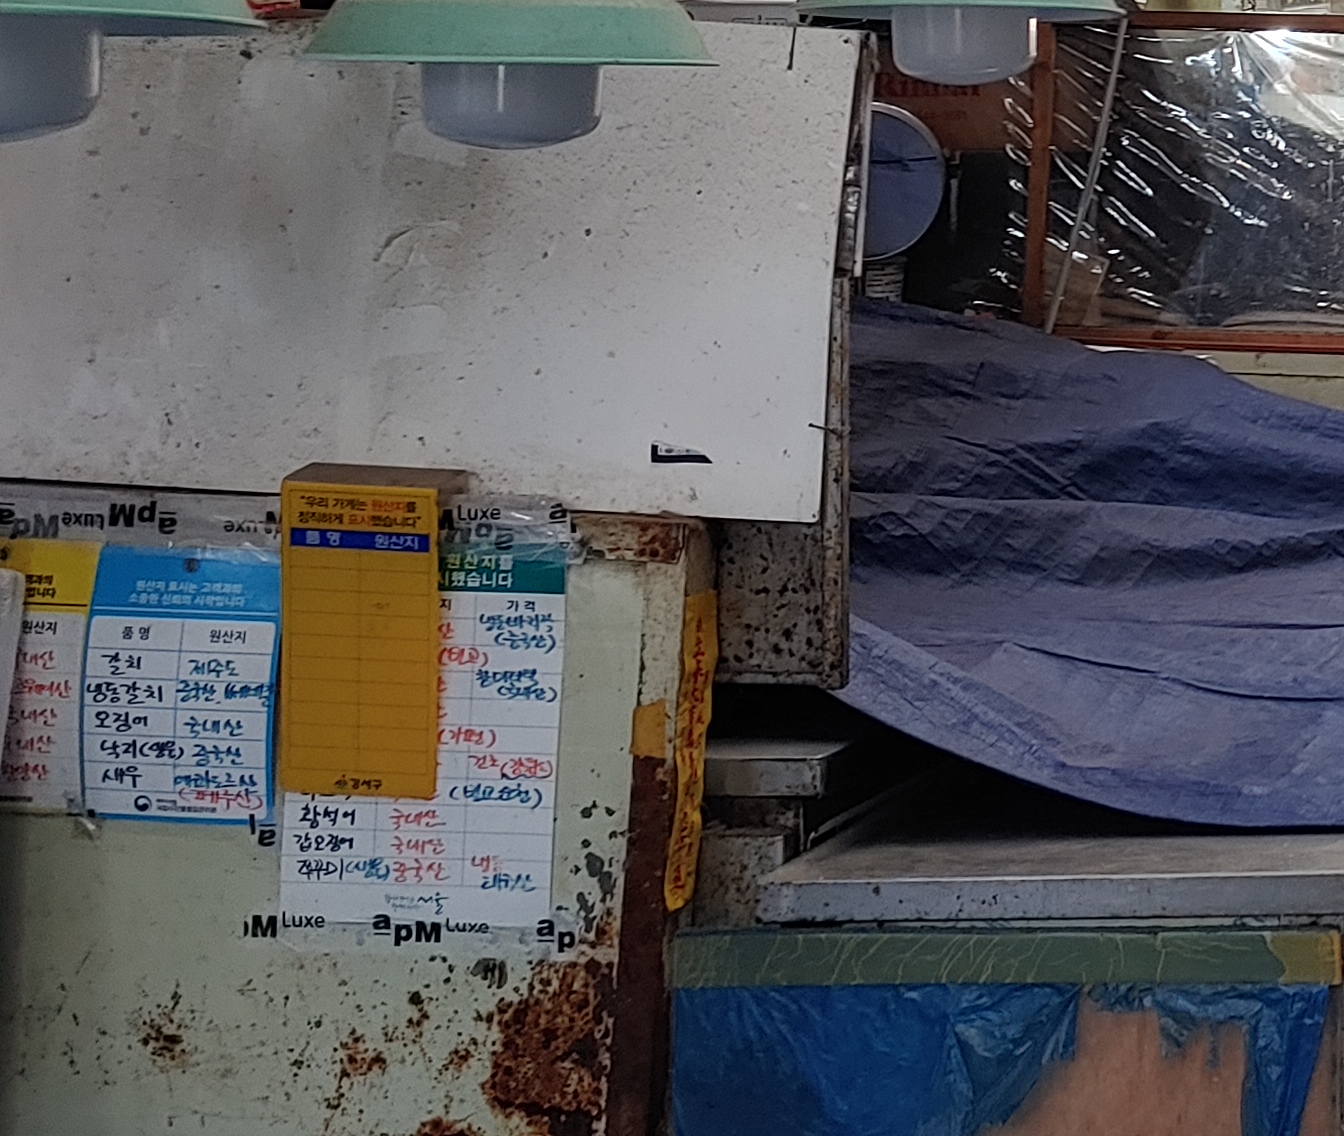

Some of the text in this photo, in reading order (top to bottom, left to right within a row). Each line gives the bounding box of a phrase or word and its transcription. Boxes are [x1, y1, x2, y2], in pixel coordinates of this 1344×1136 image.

[457, 505, 500, 521] Luxe
[374, 534, 419, 549] 원산지
[209, 630, 247, 644] 원산지
[101, 652, 142, 675] 갈치
[87, 682, 163, 704] 냉동갈치
[94, 712, 244, 737] 오징어 국내산
[101, 767, 143, 788] 새우
[390, 807, 447, 831] 국내산
[294, 833, 354, 852] 갑오징어
[392, 861, 449, 884] 중국산
[283, 914, 325, 928] Luxe
[373, 914, 490, 947] apM Luxe
